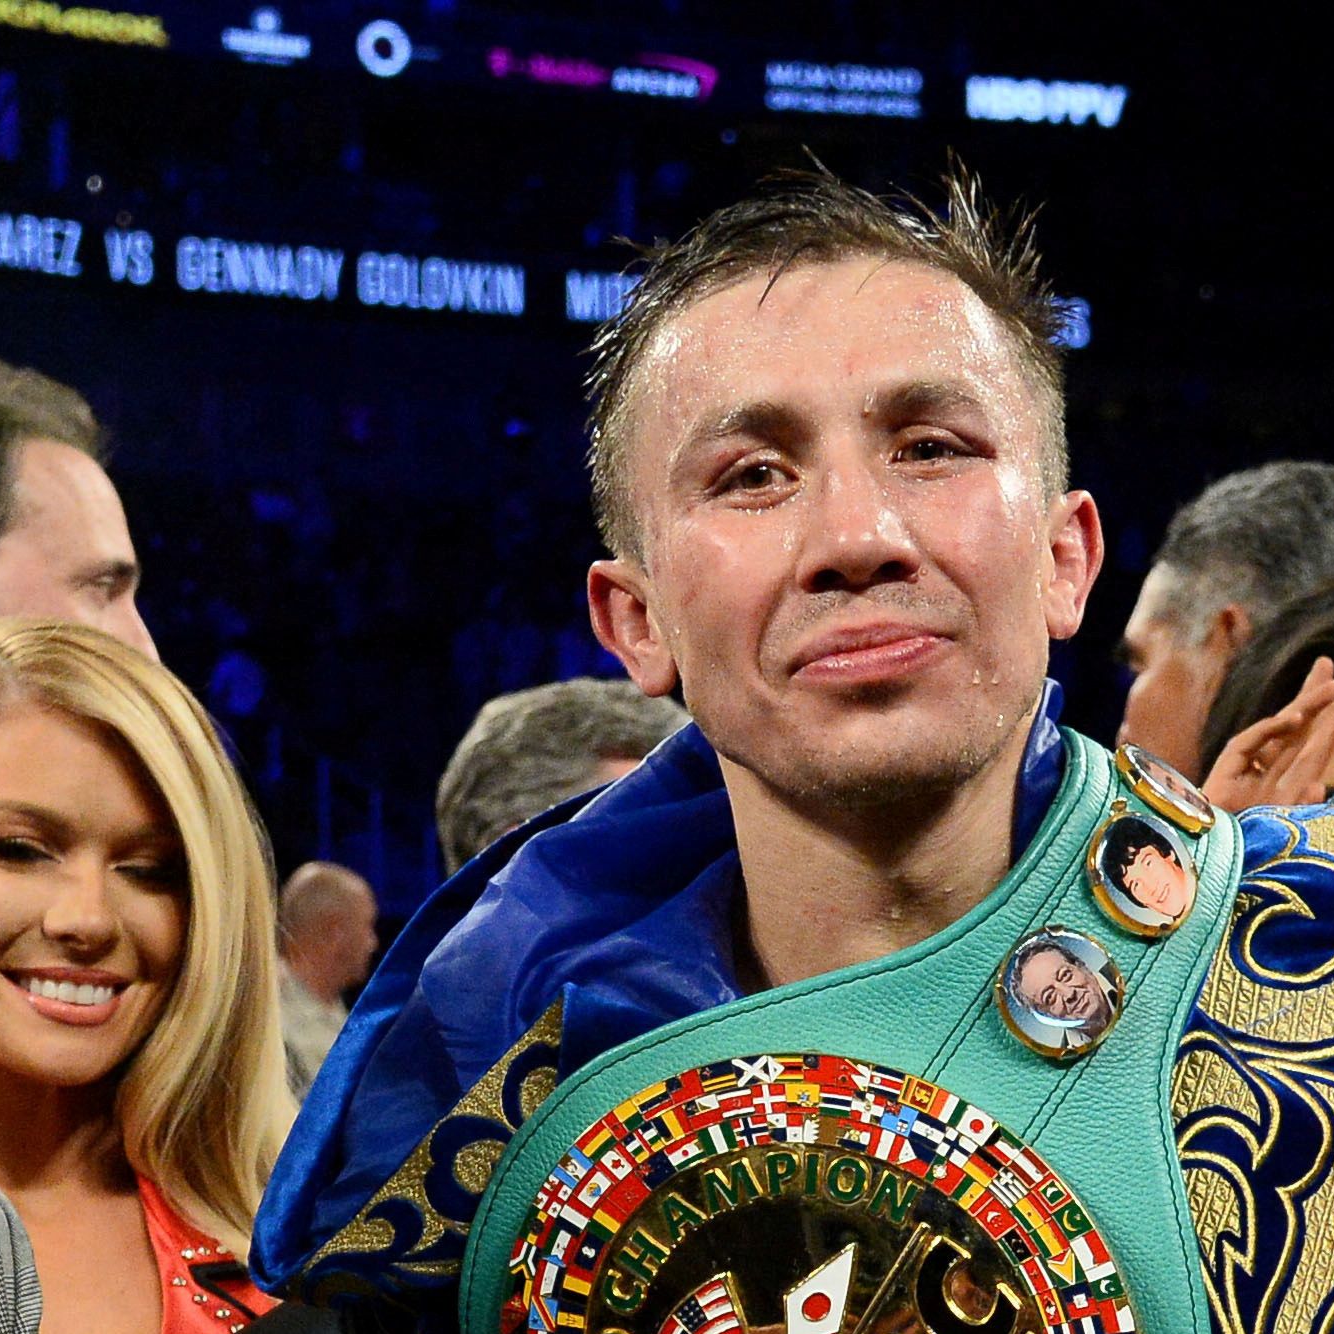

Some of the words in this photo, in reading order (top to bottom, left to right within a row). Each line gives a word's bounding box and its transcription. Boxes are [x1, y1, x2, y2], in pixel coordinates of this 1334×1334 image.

[104, 230, 154, 285] VS
[176, 237, 344, 300] GENNADY
[357, 252, 524, 315] GOLOVKIN
[602, 1150, 924, 1314] CHAMPION
